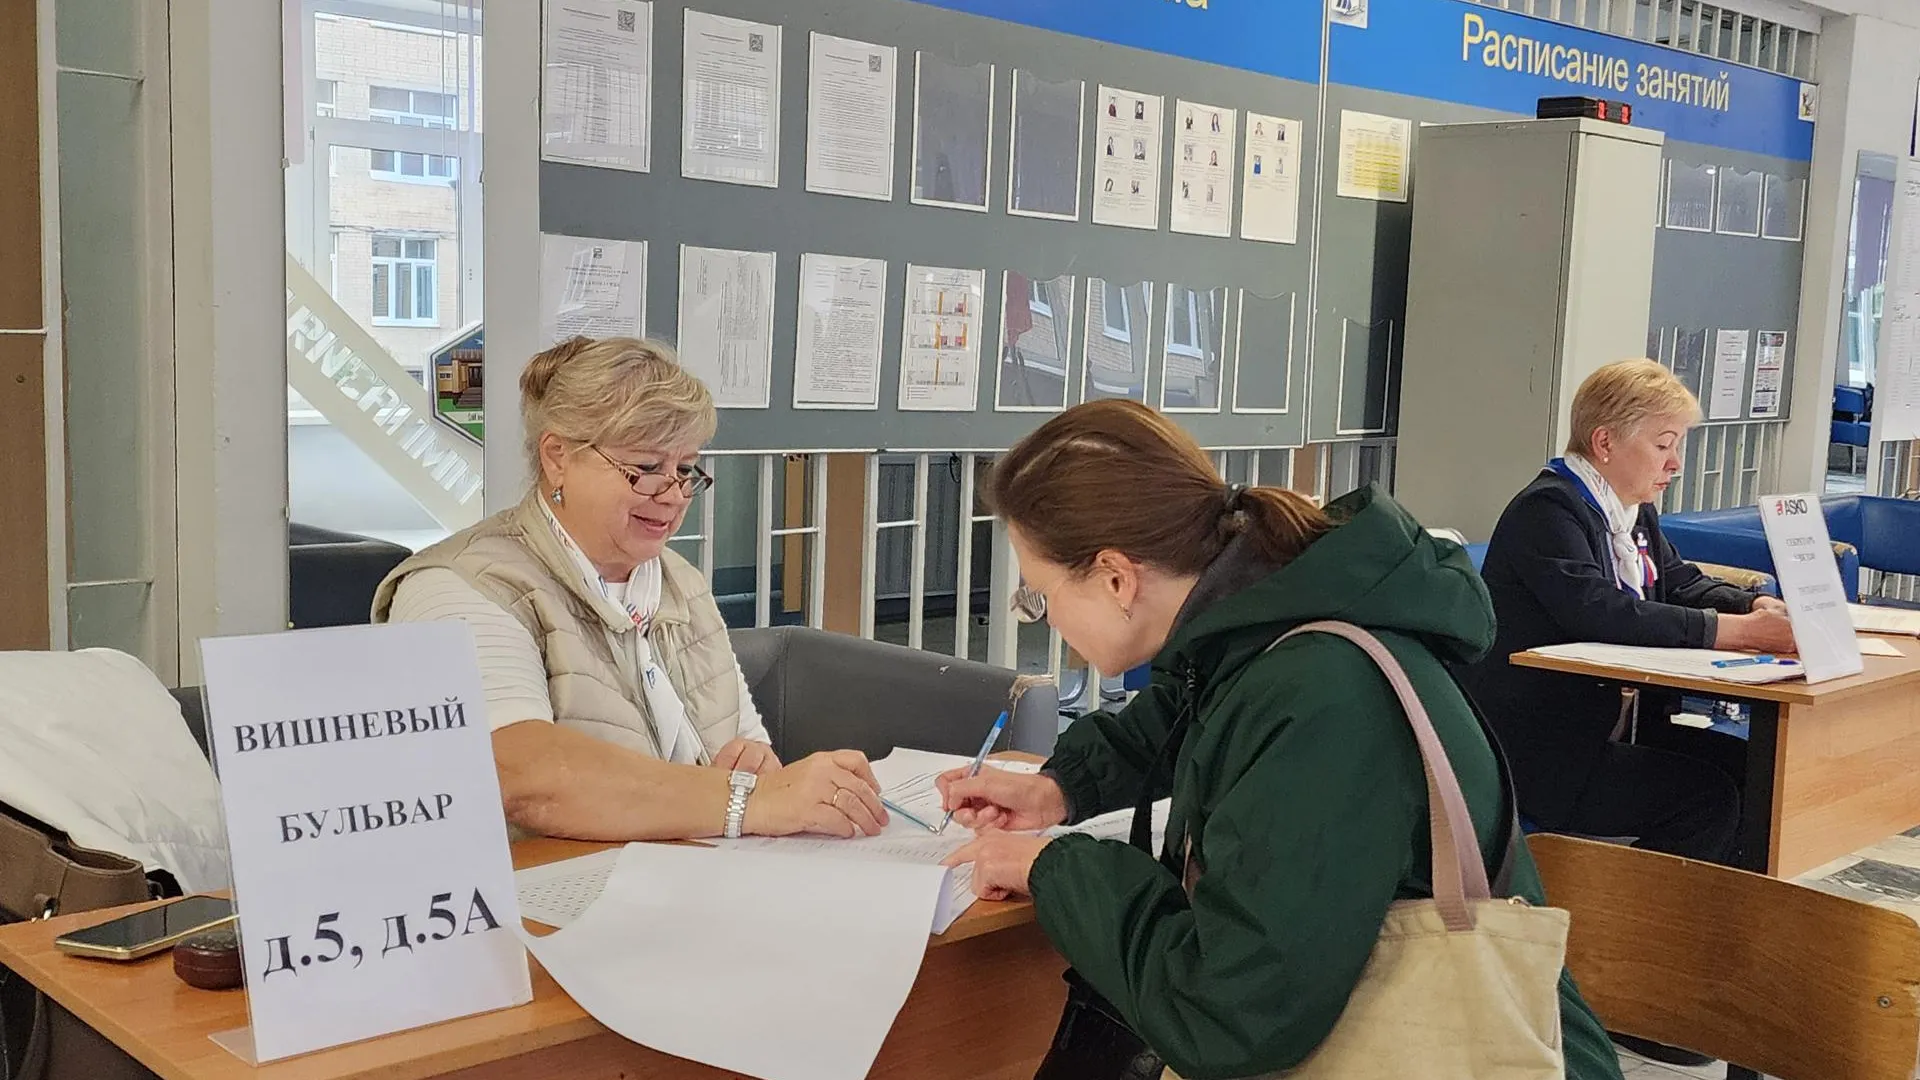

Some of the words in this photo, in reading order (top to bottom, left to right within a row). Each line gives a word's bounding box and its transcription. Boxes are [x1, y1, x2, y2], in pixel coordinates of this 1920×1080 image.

[1462, 12, 1629, 92] Расписание
[1636, 62, 1730, 112] занятий
[232, 695, 469, 754] ВИШНЕВЫЙ
[277, 793, 454, 844] БУЛЬВАР
[262, 911, 364, 983] д.5,
[381, 886, 502, 959] д.5А
